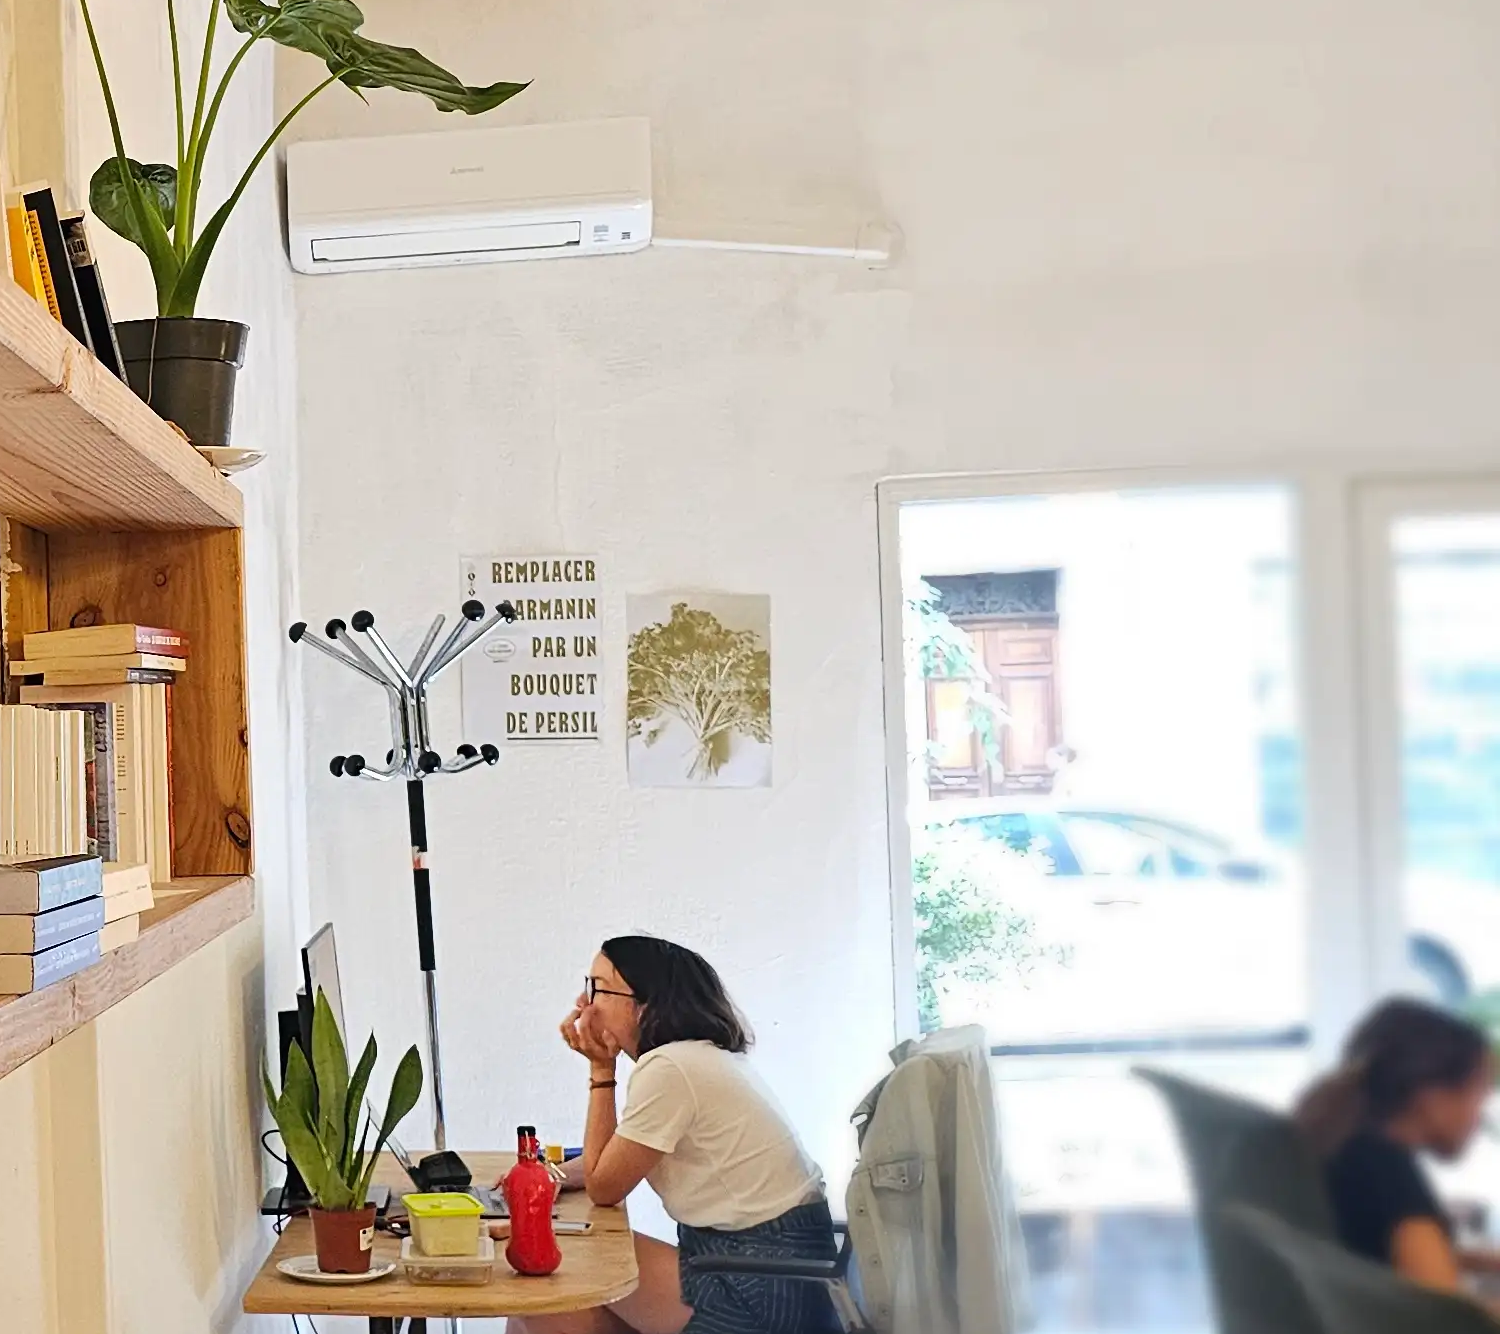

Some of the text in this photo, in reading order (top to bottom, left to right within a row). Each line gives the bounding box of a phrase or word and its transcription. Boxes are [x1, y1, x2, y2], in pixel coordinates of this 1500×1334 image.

[492, 560, 596, 584] REMPLACER
[514, 598, 597, 621] ARMANIN
[532, 636, 566, 657] PAR
[574, 635, 597, 657] UN
[511, 673, 598, 697] BOUQUET
[506, 711, 598, 733] DE PERSIL
